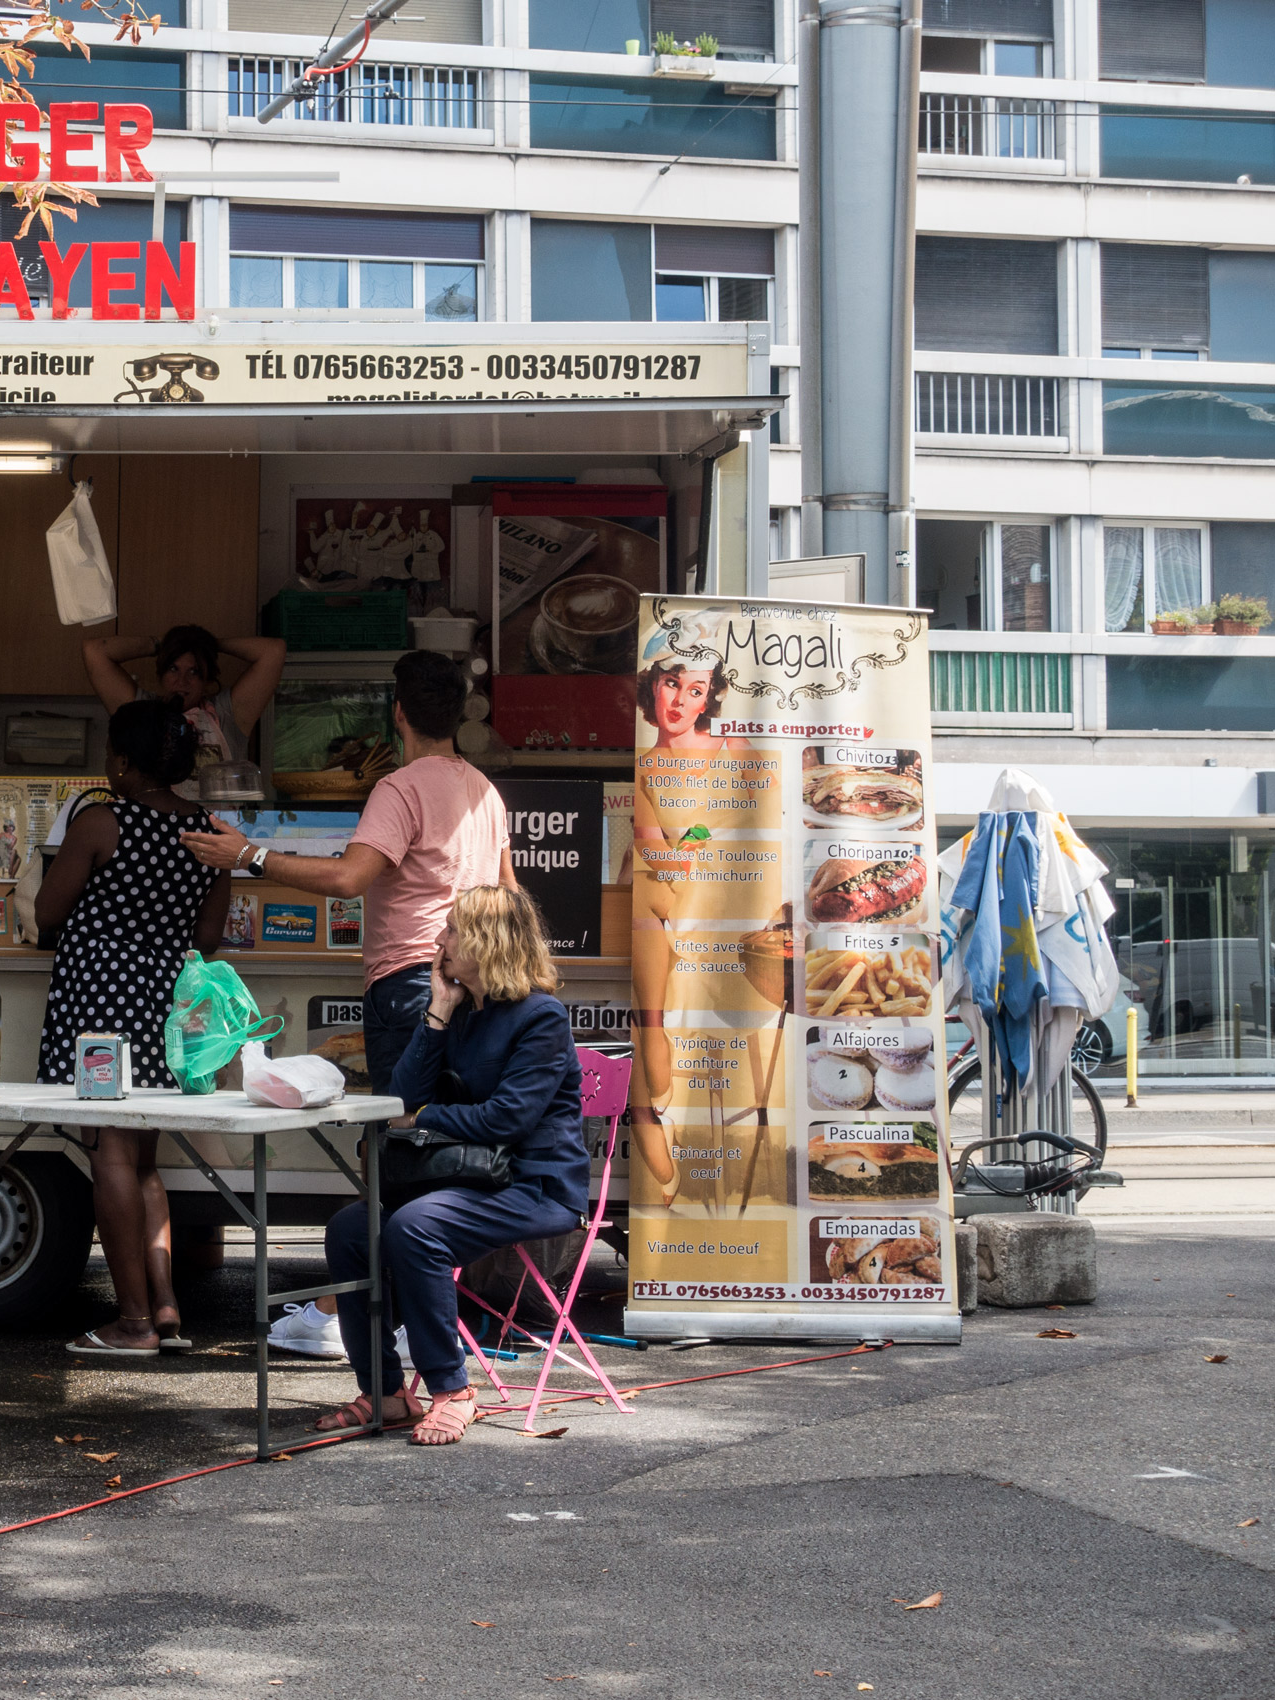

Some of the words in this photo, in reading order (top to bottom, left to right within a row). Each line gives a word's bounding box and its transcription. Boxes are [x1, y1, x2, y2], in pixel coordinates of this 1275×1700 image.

[245, 350, 286, 379] TÉL
[293, 354, 464, 380] 0765663253
[487, 354, 701, 380] 0033450791287
[740, 602, 802, 621] Bienvenue
[807, 604, 836, 622] chez
[725, 619, 844, 679] Magali
[720, 720, 763, 737] plats
[768, 724, 778, 734] a
[782, 722, 861, 738] emporter
[836, 749, 884, 764] Chivito
[638, 756, 654, 768] Le
[657, 756, 706, 770] burguer
[709, 760, 778, 772] uruguayen
[647, 776, 683, 788] 100%
[686, 776, 708, 788] filet
[712, 777, 728, 789] de
[731, 777, 771, 790] boeuf
[659, 796, 697, 808] bacon
[707, 798, 757, 811] jambon
[642, 848, 696, 861] Saucisse
[698, 850, 714, 861] de
[717, 850, 778, 862] Toulouse
[828, 845, 893, 862] Choripan
[657, 871, 687, 881] avec
[689, 869, 764, 882] chimichurri
[265, 927, 313, 937] Corvette
[674, 940, 709, 952] Frites
[712, 943, 745, 953] avec
[845, 935, 884, 949] Frites
[890, 936, 900, 947] 5
[675, 960, 697, 972] des
[700, 962, 746, 973] sauces
[674, 1037, 726, 1051] Typique
[730, 1037, 747, 1049] de
[833, 1032, 900, 1049] Alfajores
[677, 1057, 739, 1069] confiture
[838, 1069, 848, 1080] 2
[688, 1077, 706, 1089] du
[709, 1077, 731, 1089] lait
[829, 1126, 910, 1140] Pascualina
[671, 1146, 724, 1160] Epinard
[727, 1148, 741, 1159] et
[690, 1166, 723, 1179] oeuf
[857, 1161, 866, 1173] 4
[826, 1221, 916, 1238] Empanadas
[647, 1241, 694, 1253] Viande
[698, 1241, 715, 1254] de
[719, 1242, 760, 1255] boeuf
[868, 1256, 877, 1267] 4
[634, 1279, 672, 1297] TÈL
[676, 1284, 786, 1299] 0765663253
[801, 1287, 945, 1301] 0033450791287
